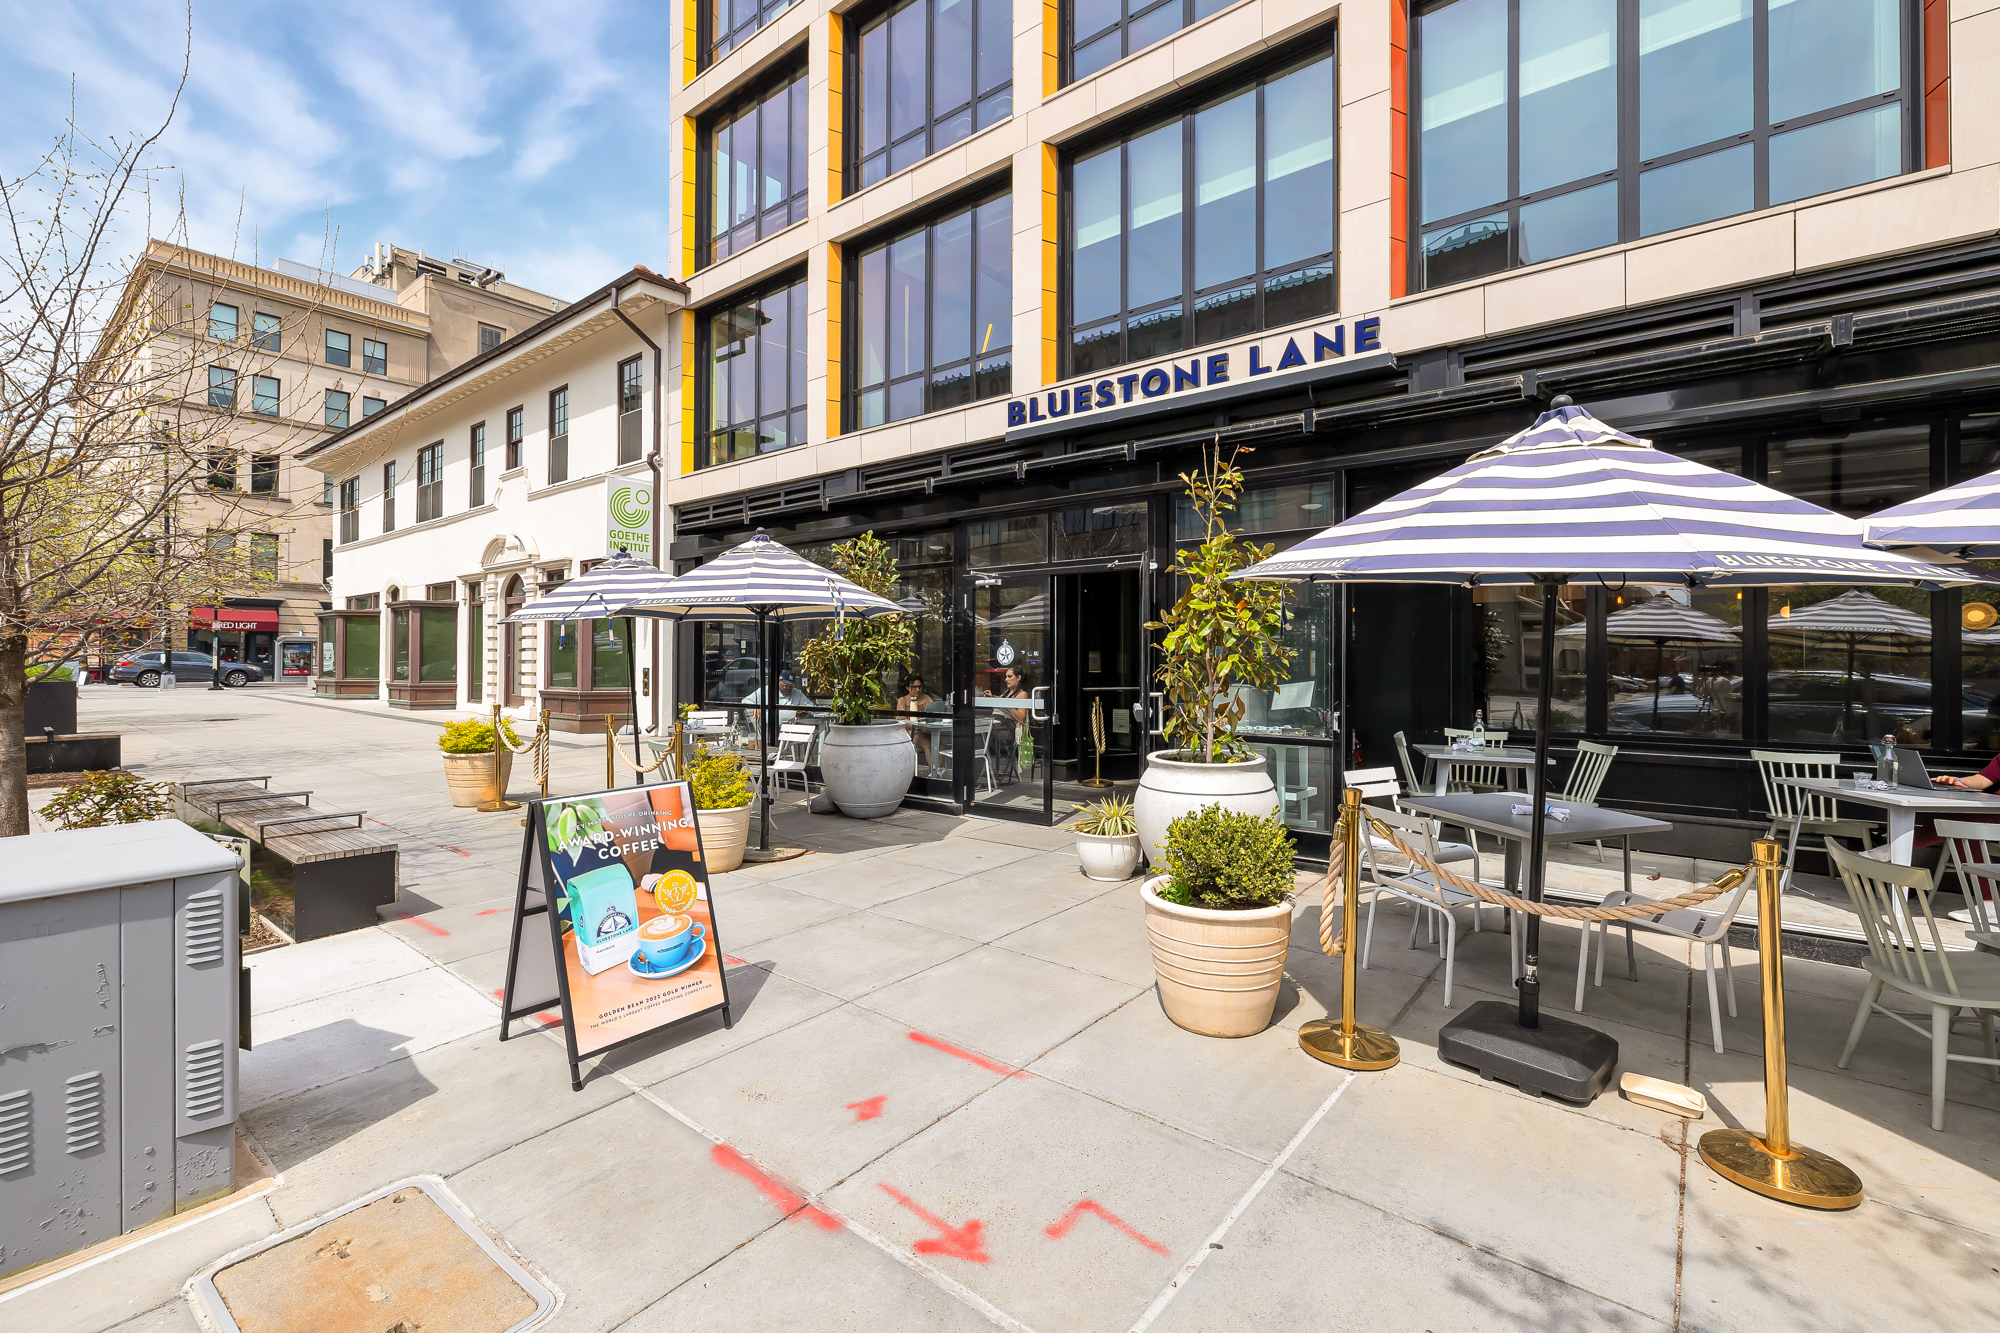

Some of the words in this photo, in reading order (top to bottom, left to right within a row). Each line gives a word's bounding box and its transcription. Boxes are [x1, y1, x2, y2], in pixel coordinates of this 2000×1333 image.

[1008, 352, 1229, 427] BLUESTONE
[1249, 316, 1382, 377] LANE
[609, 529, 649, 542] GOETHE
[609, 540, 650, 553] INSTITUT
[1715, 554, 1889, 573] BLUESTONE
[1885, 563, 1981, 578] LANE
[638, 597, 705, 605] BLUESTONE
[570, 823, 585, 833] HEY
[638, 810, 672, 818] DRINKING
[557, 817, 689, 852] AWARD-WINNING
[598, 838, 659, 860] COFFEE
[596, 931, 622, 944] BLUESTONE
[598, 1006, 625, 1019] GOLDEN
[627, 1000, 644, 1010] BEAN
[645, 994, 661, 1003] 2022
[662, 988, 679, 997] GOLD
[680, 979, 703, 991] WINNER
[601, 1015, 622, 1026] WORLD'S
[623, 1007, 643, 1018] LARGEST
[644, 1001, 661, 1010] COFFEE
[662, 993, 684, 1004] ROASTING
[684, 983, 712, 996] COMPETITION
